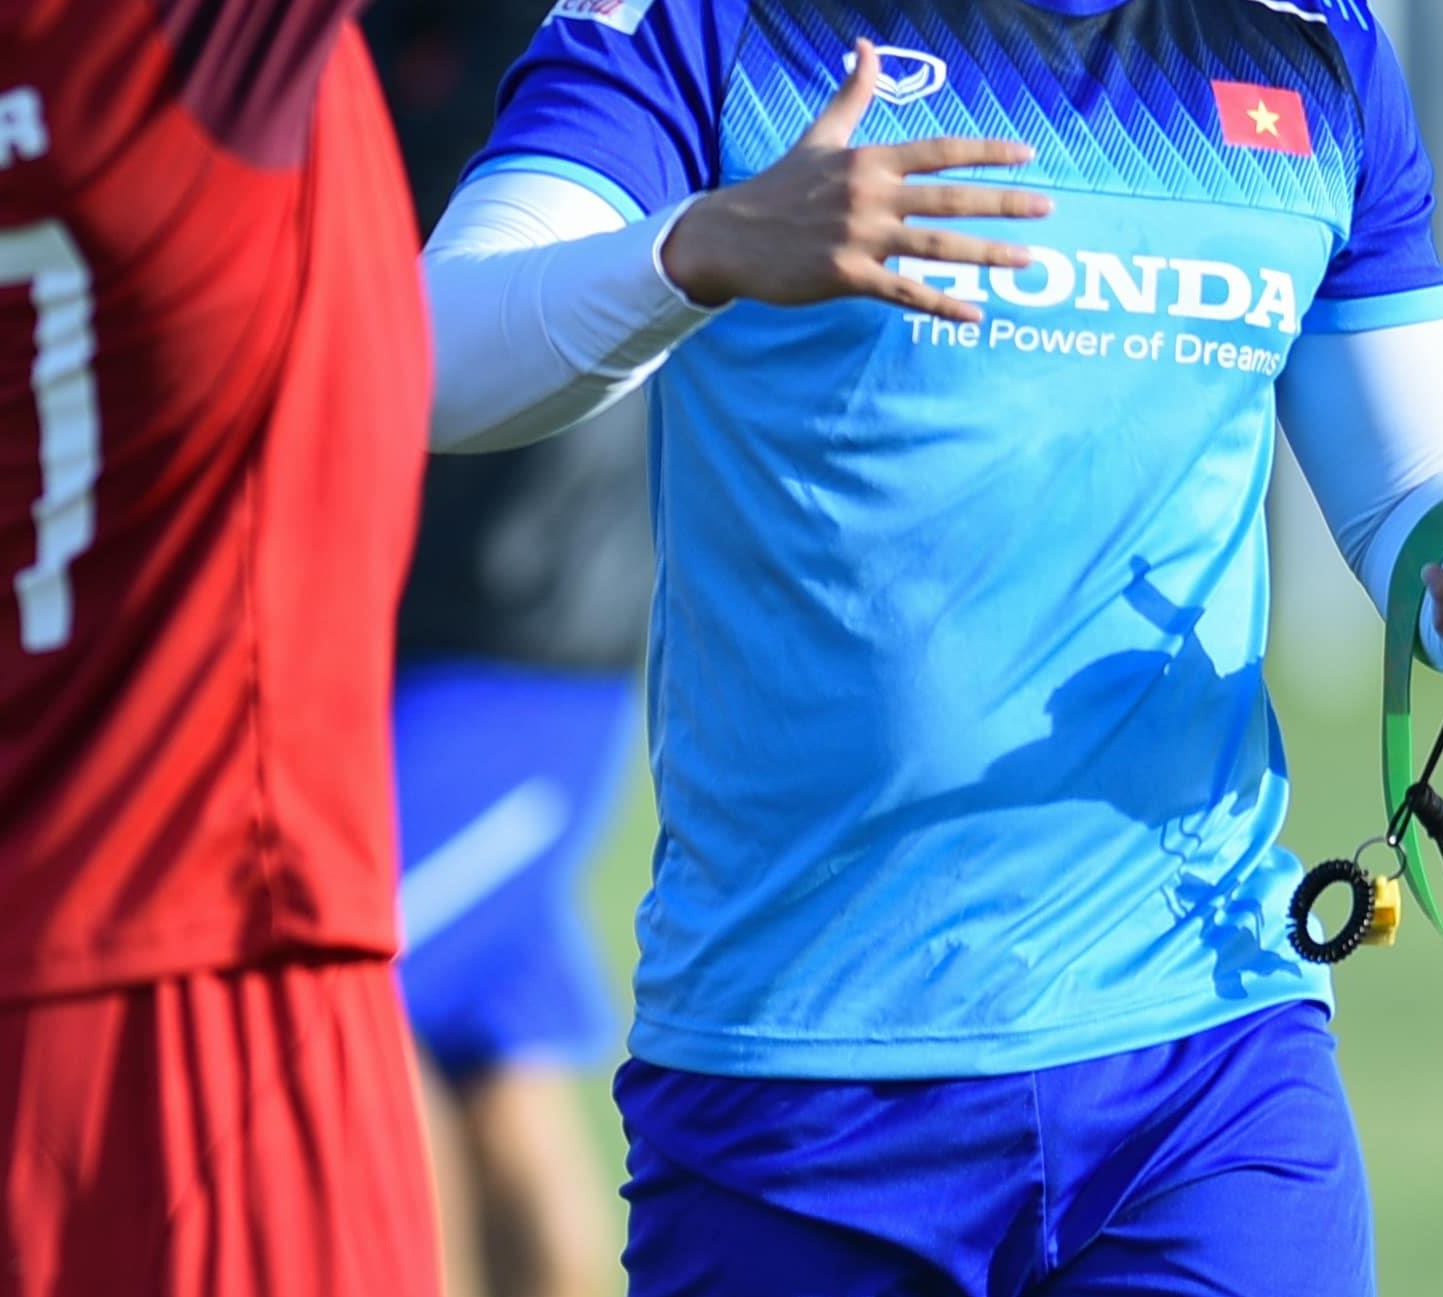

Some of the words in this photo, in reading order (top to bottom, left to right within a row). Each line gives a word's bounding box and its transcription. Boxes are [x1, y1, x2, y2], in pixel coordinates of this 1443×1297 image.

[903, 313, 981, 348] The
[988, 319, 1116, 357] Power
[1123, 331, 1165, 361] of
[1175, 332, 1280, 377] Dreams
